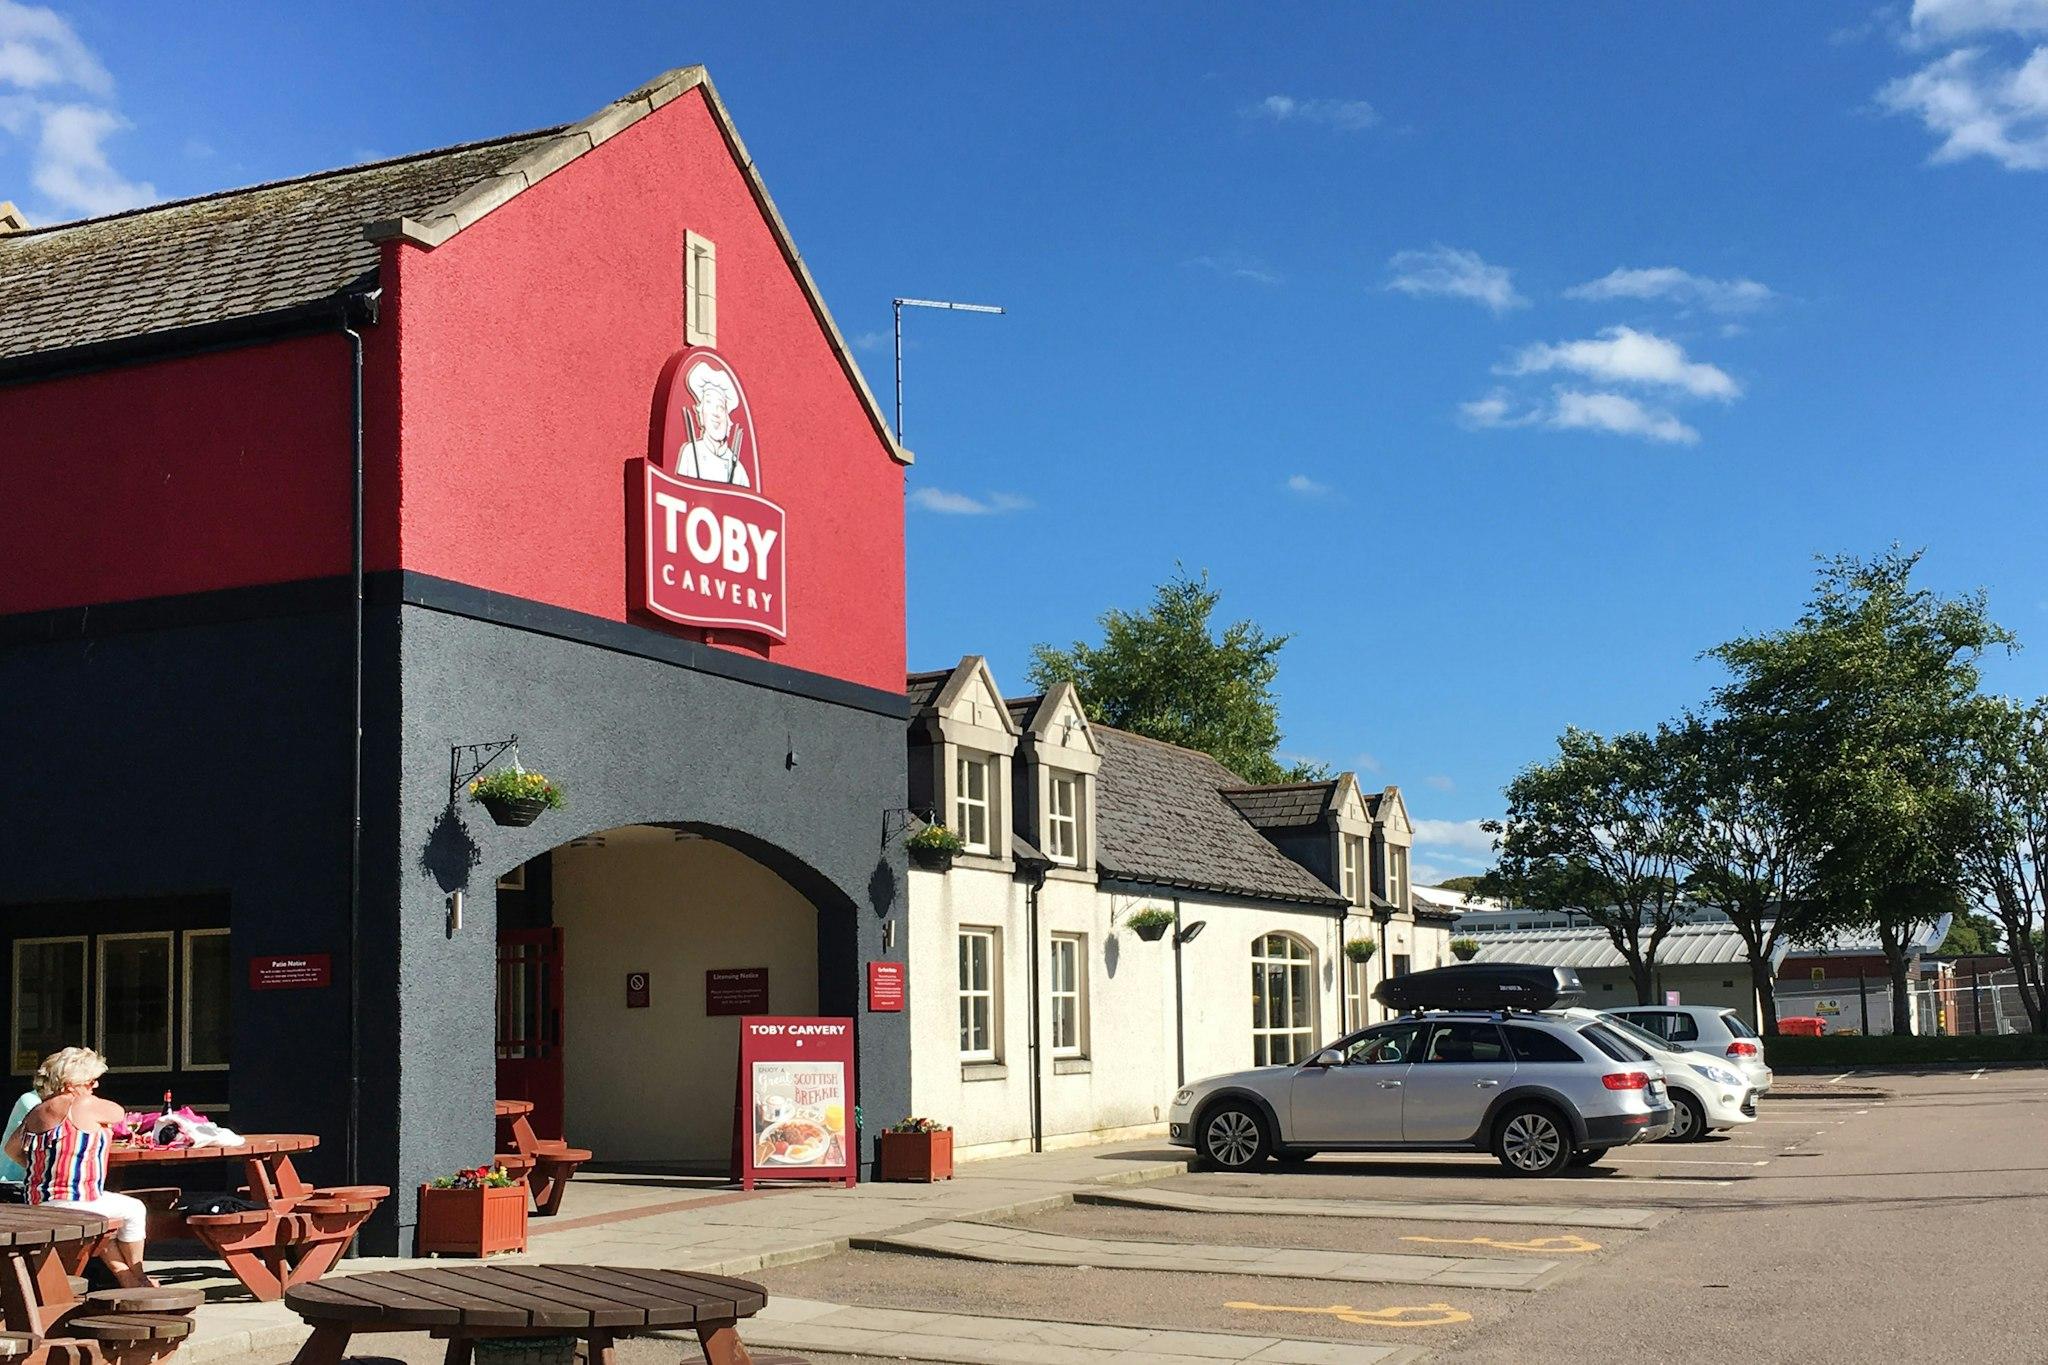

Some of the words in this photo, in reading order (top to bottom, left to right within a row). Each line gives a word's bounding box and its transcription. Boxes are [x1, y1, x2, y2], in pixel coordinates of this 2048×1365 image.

[656, 491, 778, 581] TOBY
[662, 563, 773, 613] CARVERY
[750, 1025, 786, 1035] TOBY
[788, 1025, 846, 1035] CARVERY
[794, 1073, 838, 1085] SCOTTISH
[794, 1086, 839, 1105] BREKKIE
